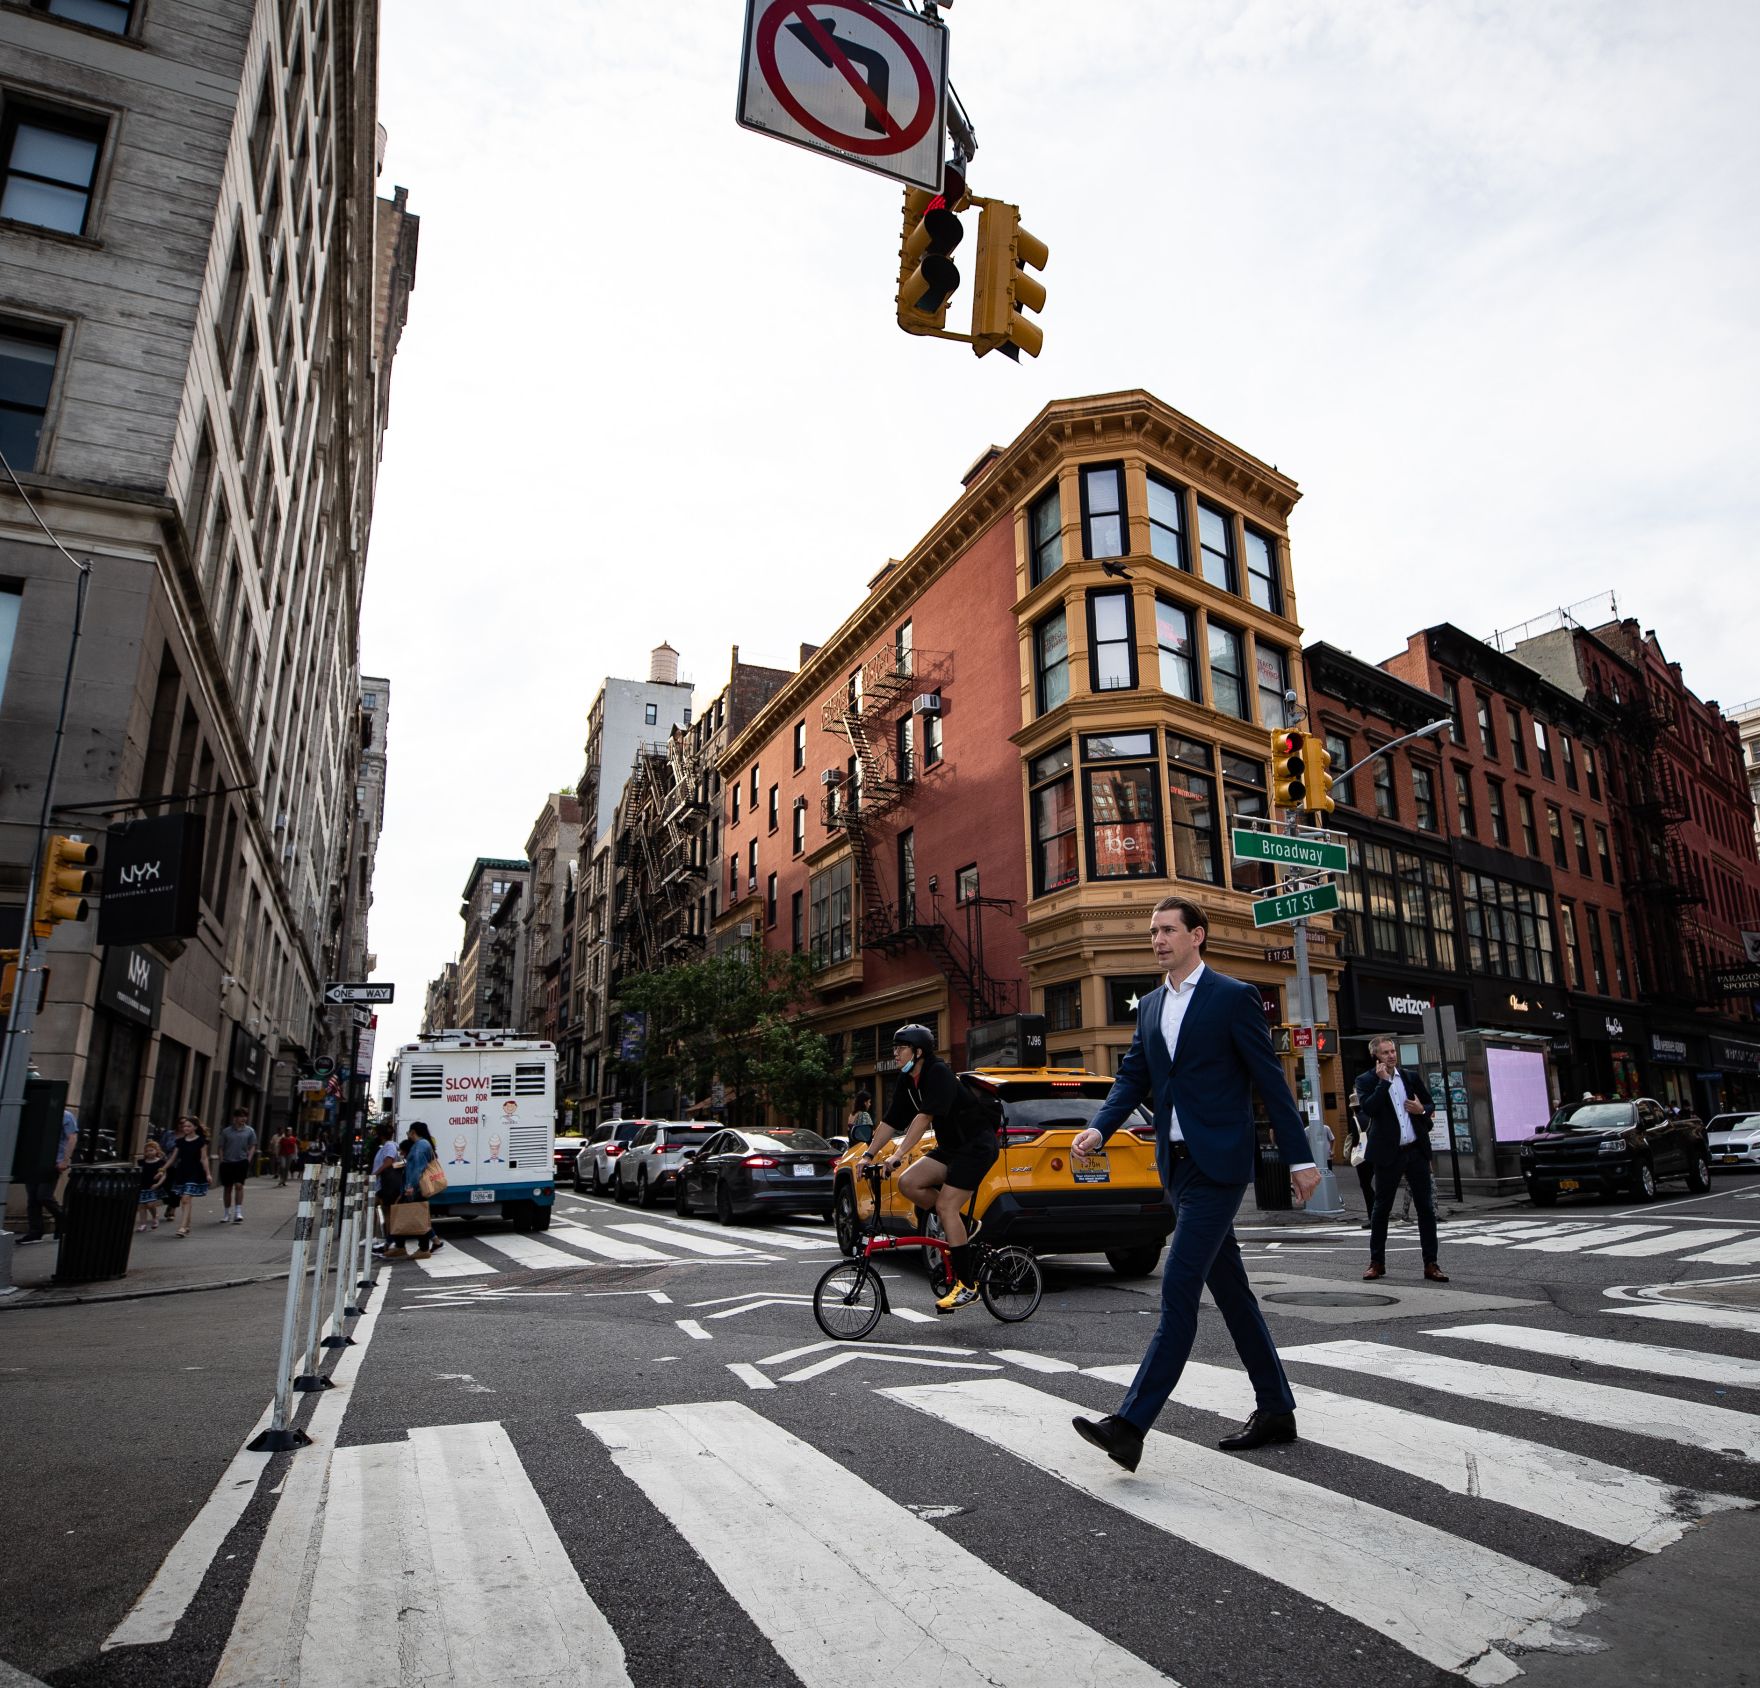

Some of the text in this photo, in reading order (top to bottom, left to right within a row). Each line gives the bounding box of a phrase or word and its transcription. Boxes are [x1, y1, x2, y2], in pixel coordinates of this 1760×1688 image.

[1262, 840, 1323, 866] Broadway
[120, 860, 160, 885] NYX
[1275, 893, 1315, 917] E 17 St
[1267, 950, 1290, 961] E 17 St
[127, 950, 151, 991] NYX
[1723, 981, 1760, 990] SPORTS
[333, 989, 389, 998] ONE WAY
[1026, 1035, 1042, 1046] 7J96
[445, 1077, 490, 1090] SLOW!
[446, 1093, 488, 1102] WATCH FOR
[464, 1106, 478, 1114] OUR
[448, 1117, 478, 1125] CHILDREN
